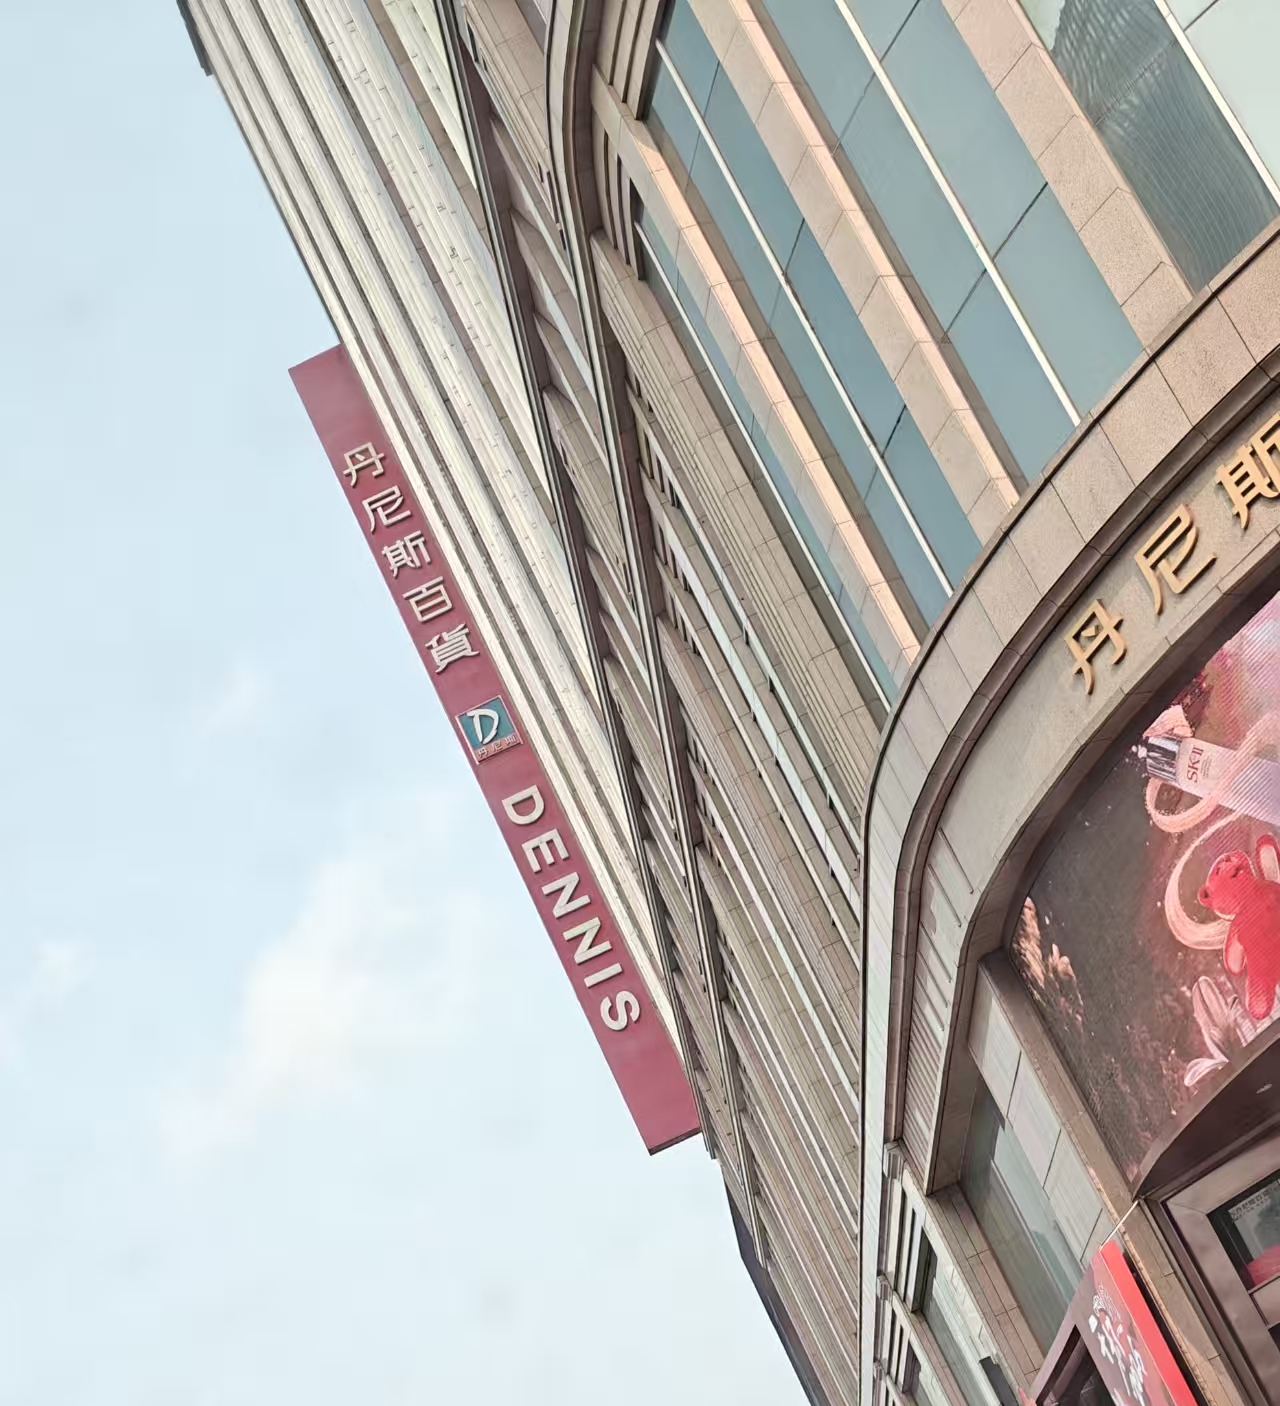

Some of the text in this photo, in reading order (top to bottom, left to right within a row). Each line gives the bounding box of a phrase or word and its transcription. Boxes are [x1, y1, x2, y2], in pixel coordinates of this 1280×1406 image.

[342, 441, 480, 674] 丹尼斯百貨
[1063, 412, 1280, 696] 丹尼斯
[502, 785, 641, 1033] DENNIS
